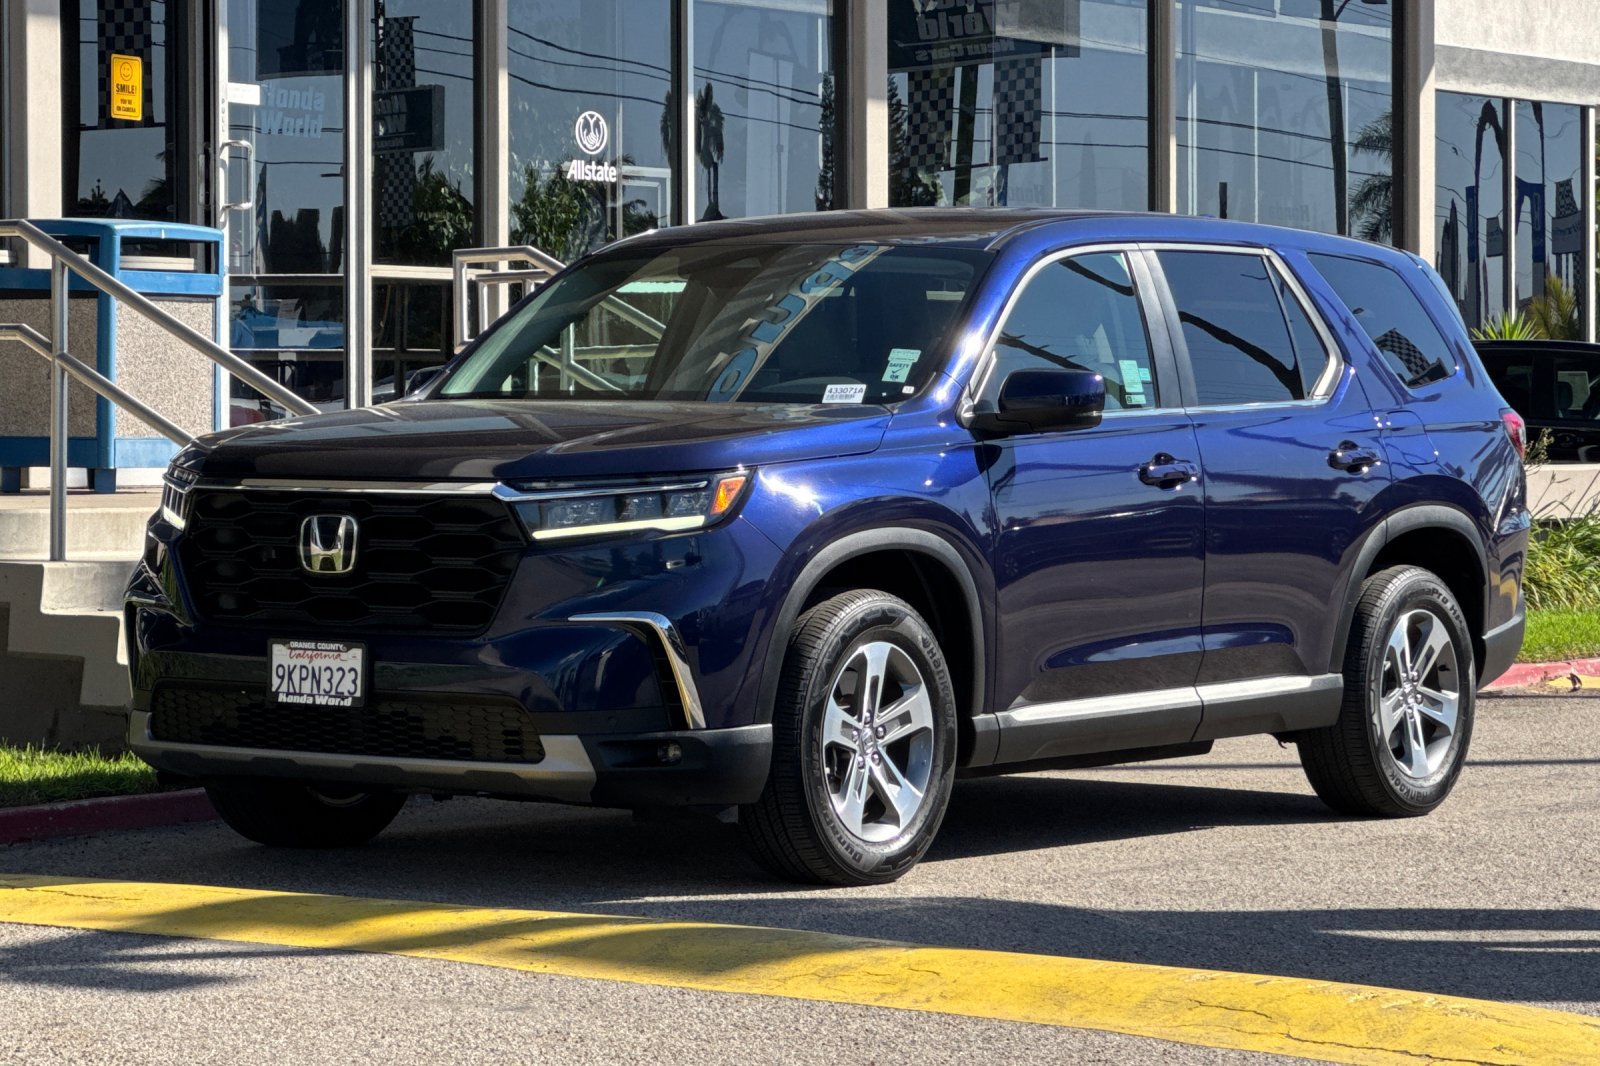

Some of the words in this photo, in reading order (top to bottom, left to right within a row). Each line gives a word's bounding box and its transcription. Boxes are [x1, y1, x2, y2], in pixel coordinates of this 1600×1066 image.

[115, 83, 137, 95] SMILE!
[260, 109, 323, 138] World
[567, 159, 616, 182] Allstate
[827, 386, 864, 394] 433071A
[289, 641, 316, 650] ORANGE
[316, 642, 344, 651] COUNTY
[288, 649, 348, 664] California
[275, 663, 358, 695] 9KPN323
[278, 692, 313, 704] Honda
[314, 694, 352, 707] World
